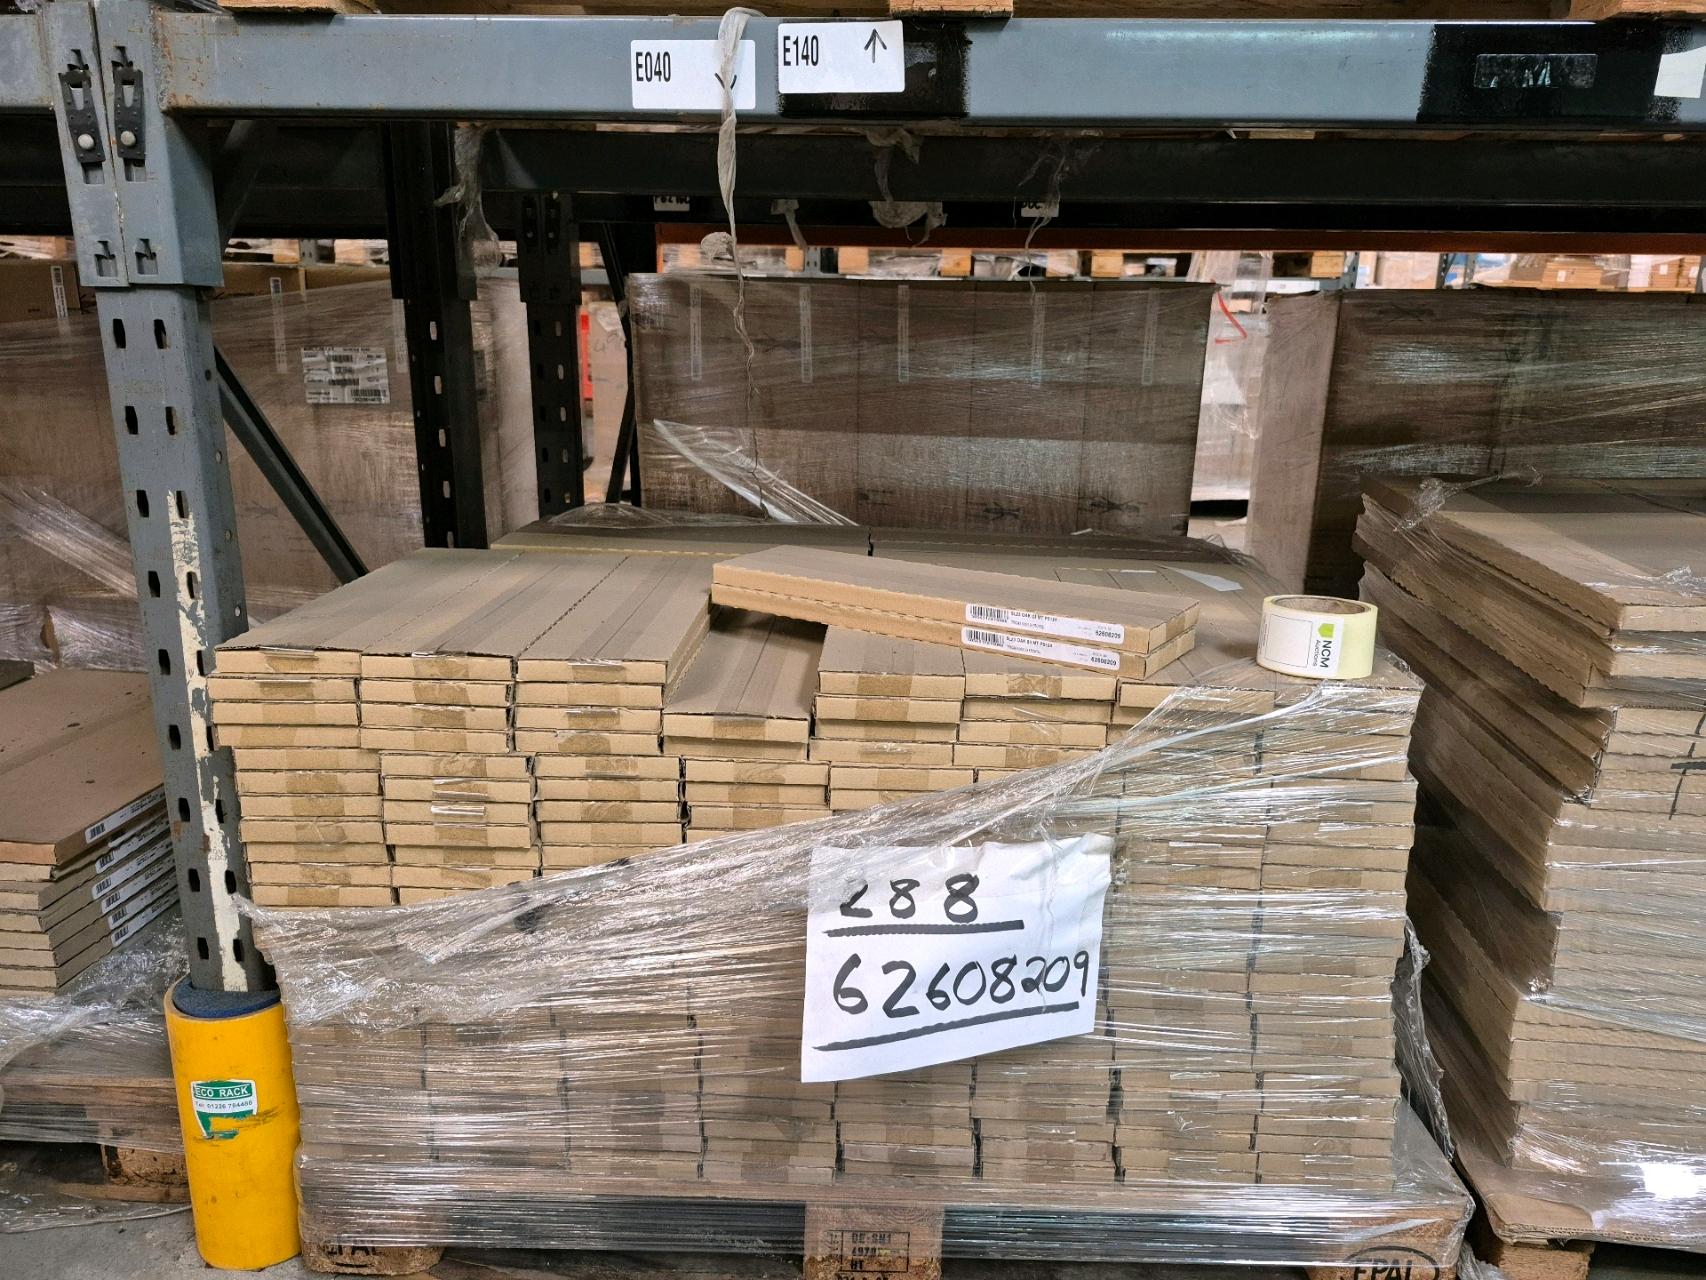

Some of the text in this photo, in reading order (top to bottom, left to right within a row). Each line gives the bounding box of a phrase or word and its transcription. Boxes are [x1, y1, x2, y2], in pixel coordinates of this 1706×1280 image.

[783, 35, 819, 67] E140
[635, 51, 671, 83] E040
[1313, 639, 1321, 667] Auctions
[1320, 640, 1333, 668] NCM
[833, 950, 1090, 1019] 62608209
[194, 1084, 249, 1098] ECO RACK
